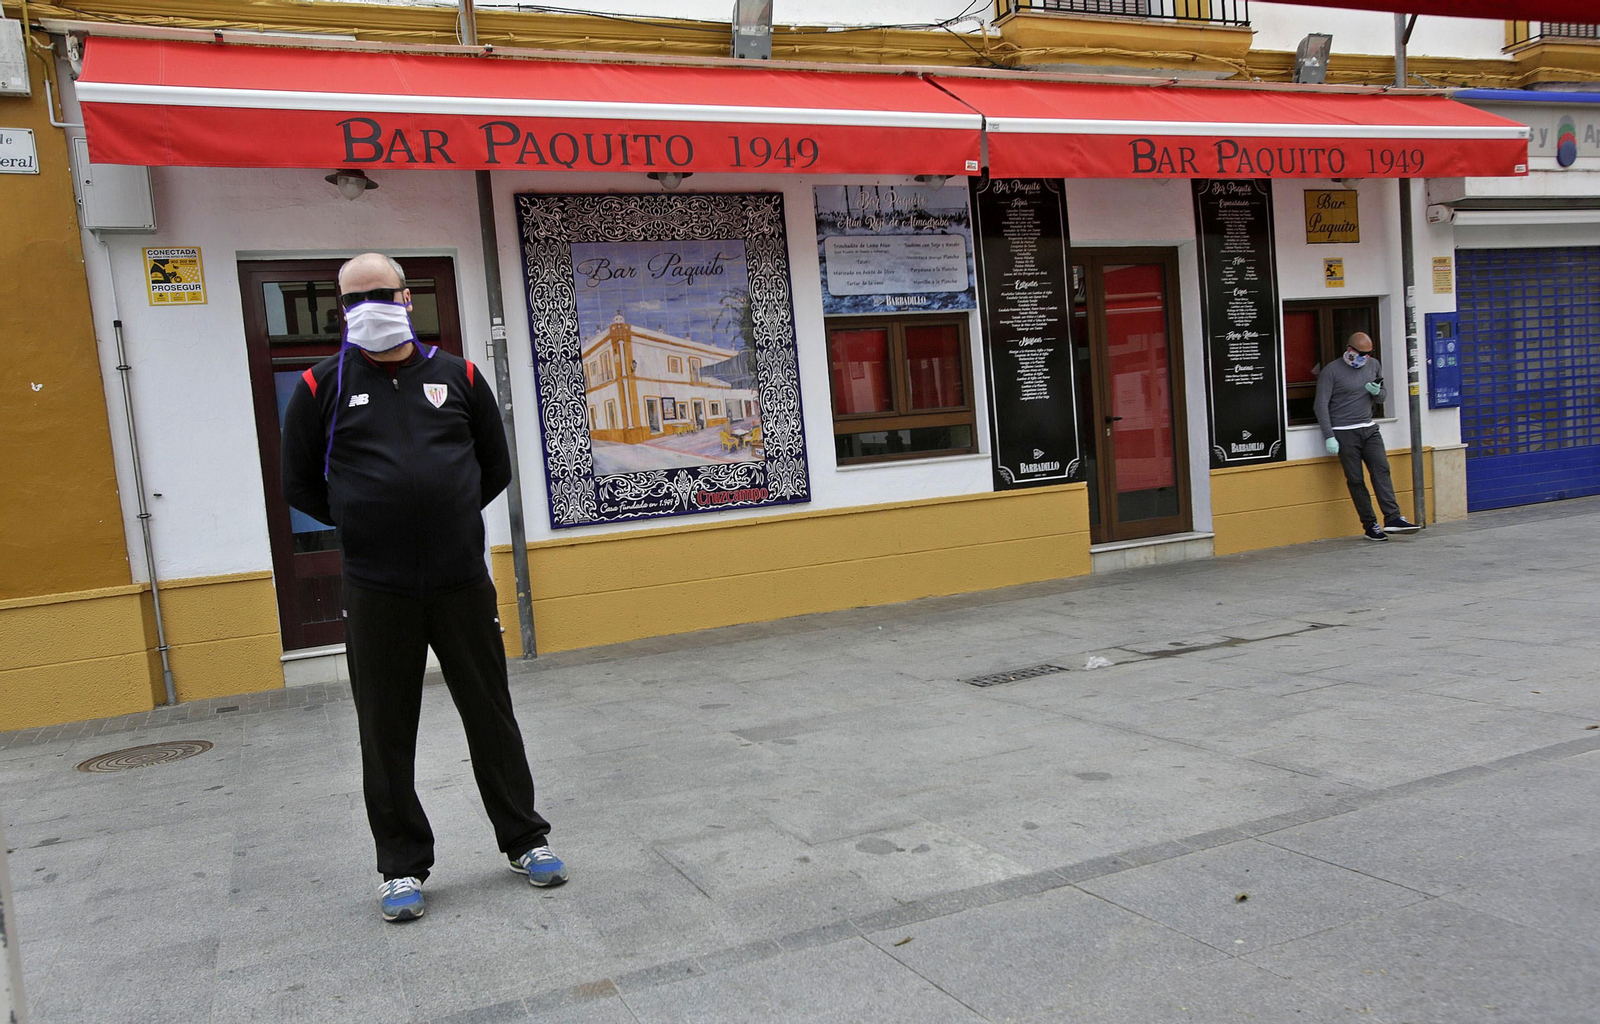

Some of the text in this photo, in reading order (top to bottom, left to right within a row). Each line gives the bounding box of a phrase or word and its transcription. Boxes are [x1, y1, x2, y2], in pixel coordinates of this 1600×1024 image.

[336, 117, 819, 169] BAR PAQUITO 1949
[1128, 138, 1425, 176] BAR PAQUITO 1949
[993, 179, 1041, 194] Bar Paquito
[1211, 181, 1252, 196] Bar Paquito
[857, 190, 928, 211] Bar Paquito
[1316, 192, 1347, 210] Bar
[889, 217, 900, 227] de
[901, 215, 950, 230] Almadraba
[1307, 212, 1358, 239] Paquito
[576, 251, 742, 288] Bar Paquito
[886, 295, 927, 306] BARBADILLO
[348, 393, 370, 407] NB
[1231, 441, 1265, 453] BARBADILLO
[1020, 461, 1060, 474] BARBADILLO
[696, 487, 769, 506] Cruzcampo
[600, 503, 618, 514] Casa
